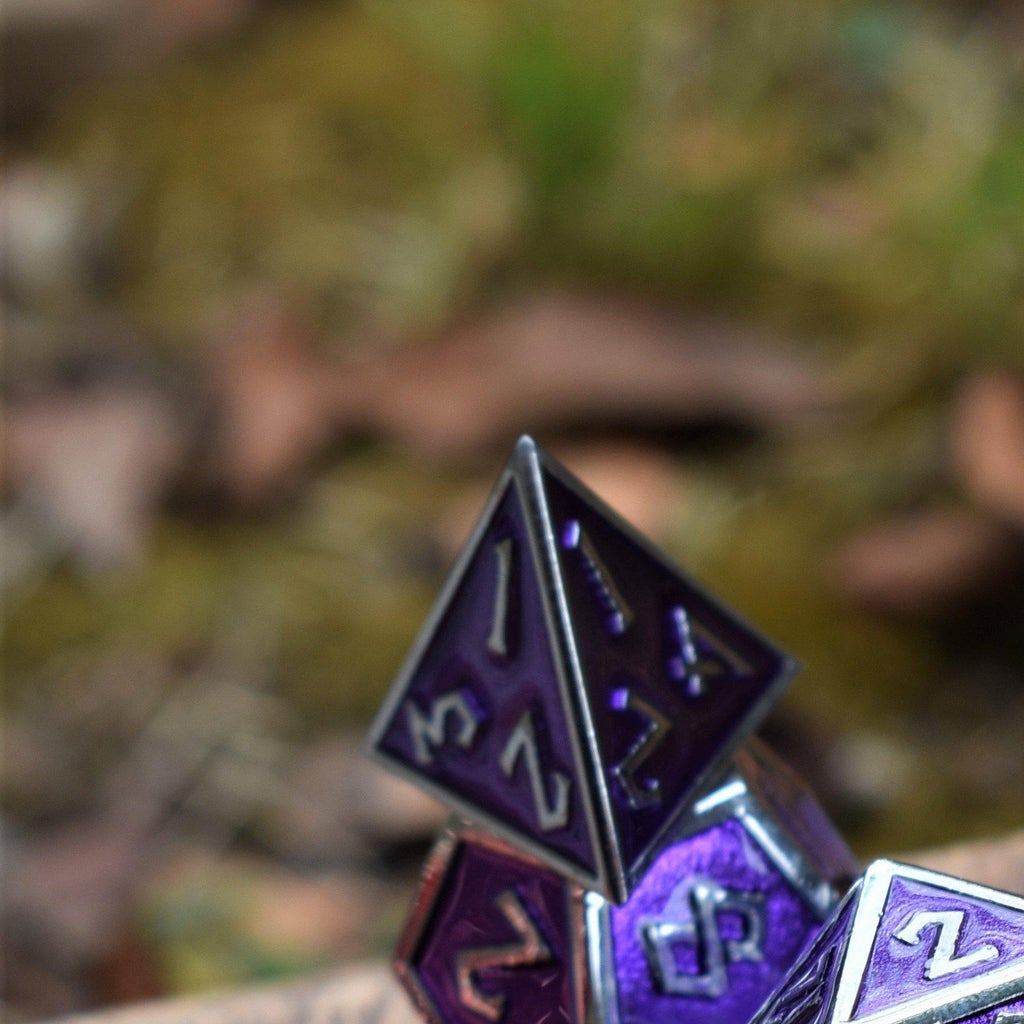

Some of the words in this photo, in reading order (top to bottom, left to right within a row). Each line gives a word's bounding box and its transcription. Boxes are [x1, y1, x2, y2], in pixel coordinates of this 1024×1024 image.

[486, 538, 513, 657] 1
[406, 690, 482, 768] 3
[500, 709, 573, 832] 2
[892, 909, 1001, 982] 2
